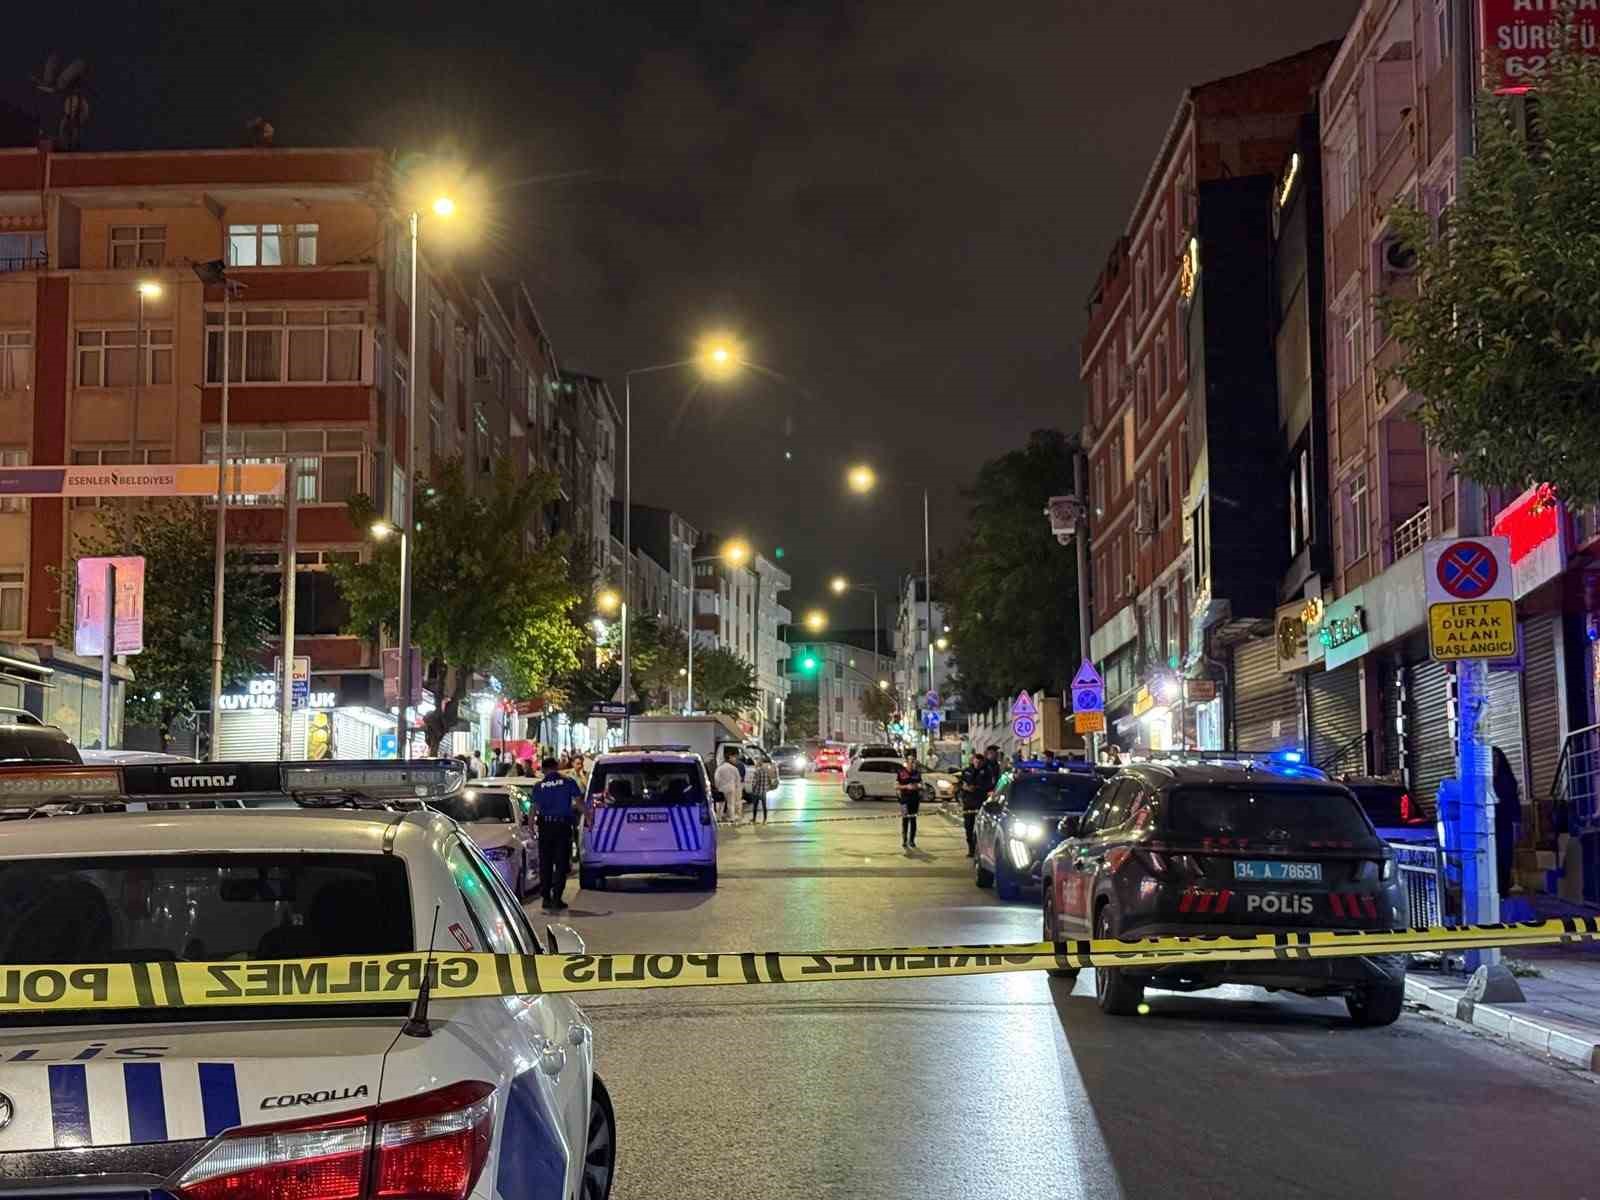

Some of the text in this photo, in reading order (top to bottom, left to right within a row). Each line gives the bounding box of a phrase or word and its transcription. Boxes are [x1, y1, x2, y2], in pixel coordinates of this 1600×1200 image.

[1497, 20, 1595, 49] SÜRÜÜ
[69, 476, 110, 486] ESENLER
[1442, 617, 1502, 629] DURAK
[1447, 630, 1499, 641] ALANI
[1435, 641, 1512, 656] BAŞLANGICI
[1017, 721, 1031, 732] 20
[170, 775, 237, 787] armas
[1238, 863, 1318, 879] 34 A 78651
[260, 1085, 368, 1109] COROLLA
